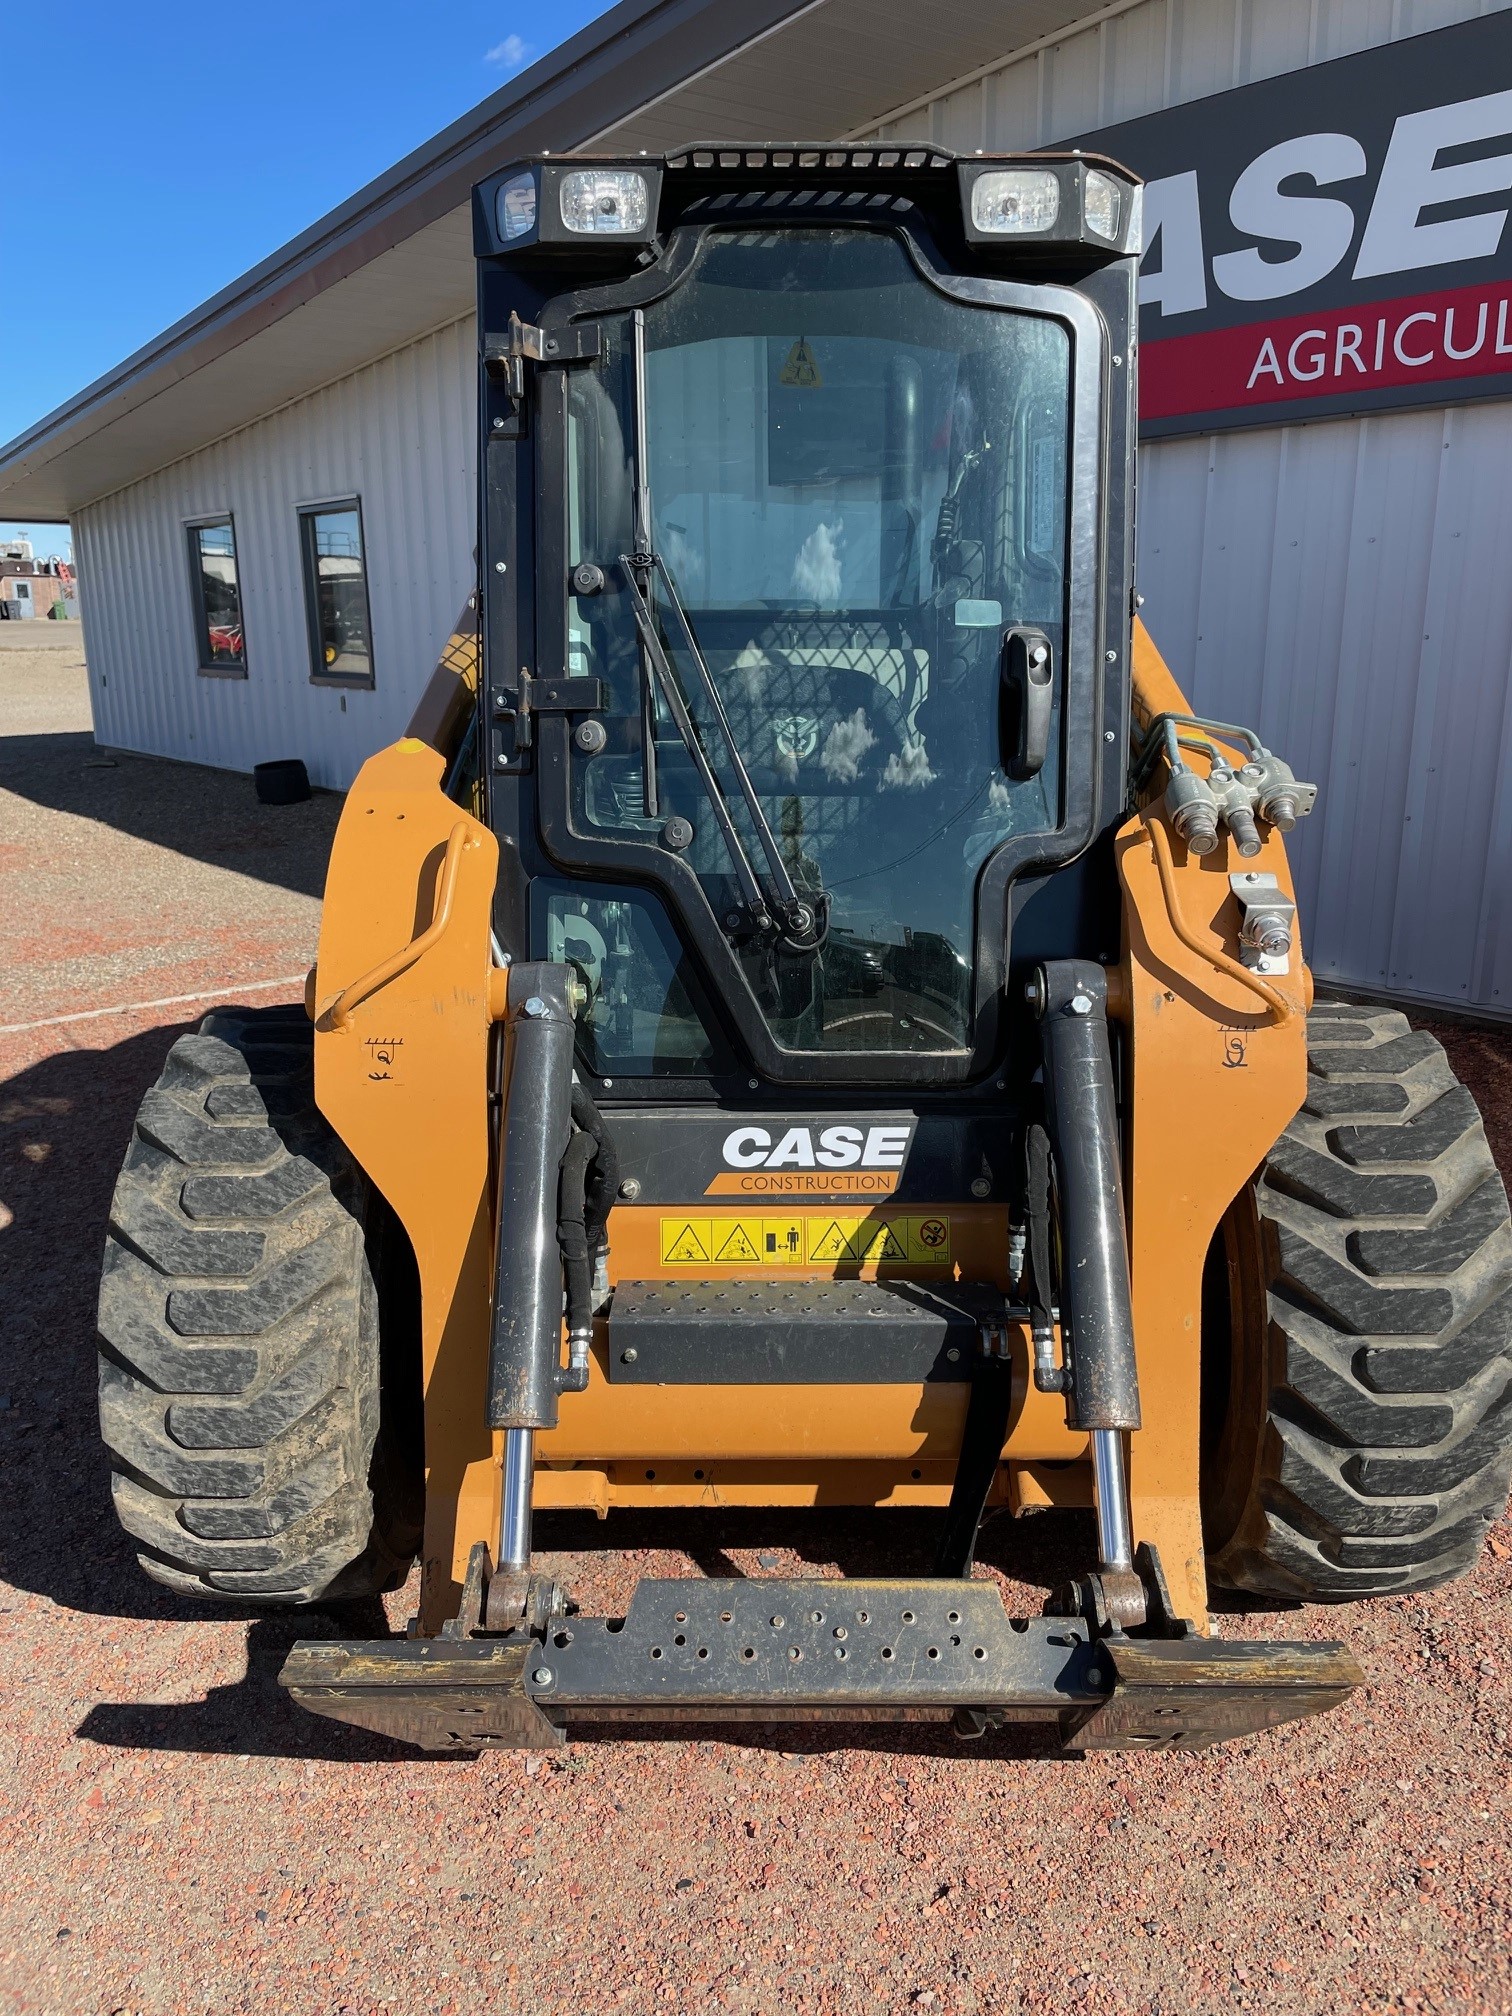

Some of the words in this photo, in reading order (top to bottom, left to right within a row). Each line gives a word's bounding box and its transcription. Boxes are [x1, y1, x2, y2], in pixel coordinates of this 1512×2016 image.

[1246, 298, 1512, 390] AGRICUL
[722, 1126, 911, 1168] CASE
[740, 1175, 891, 1191] CONSTRUCTION
